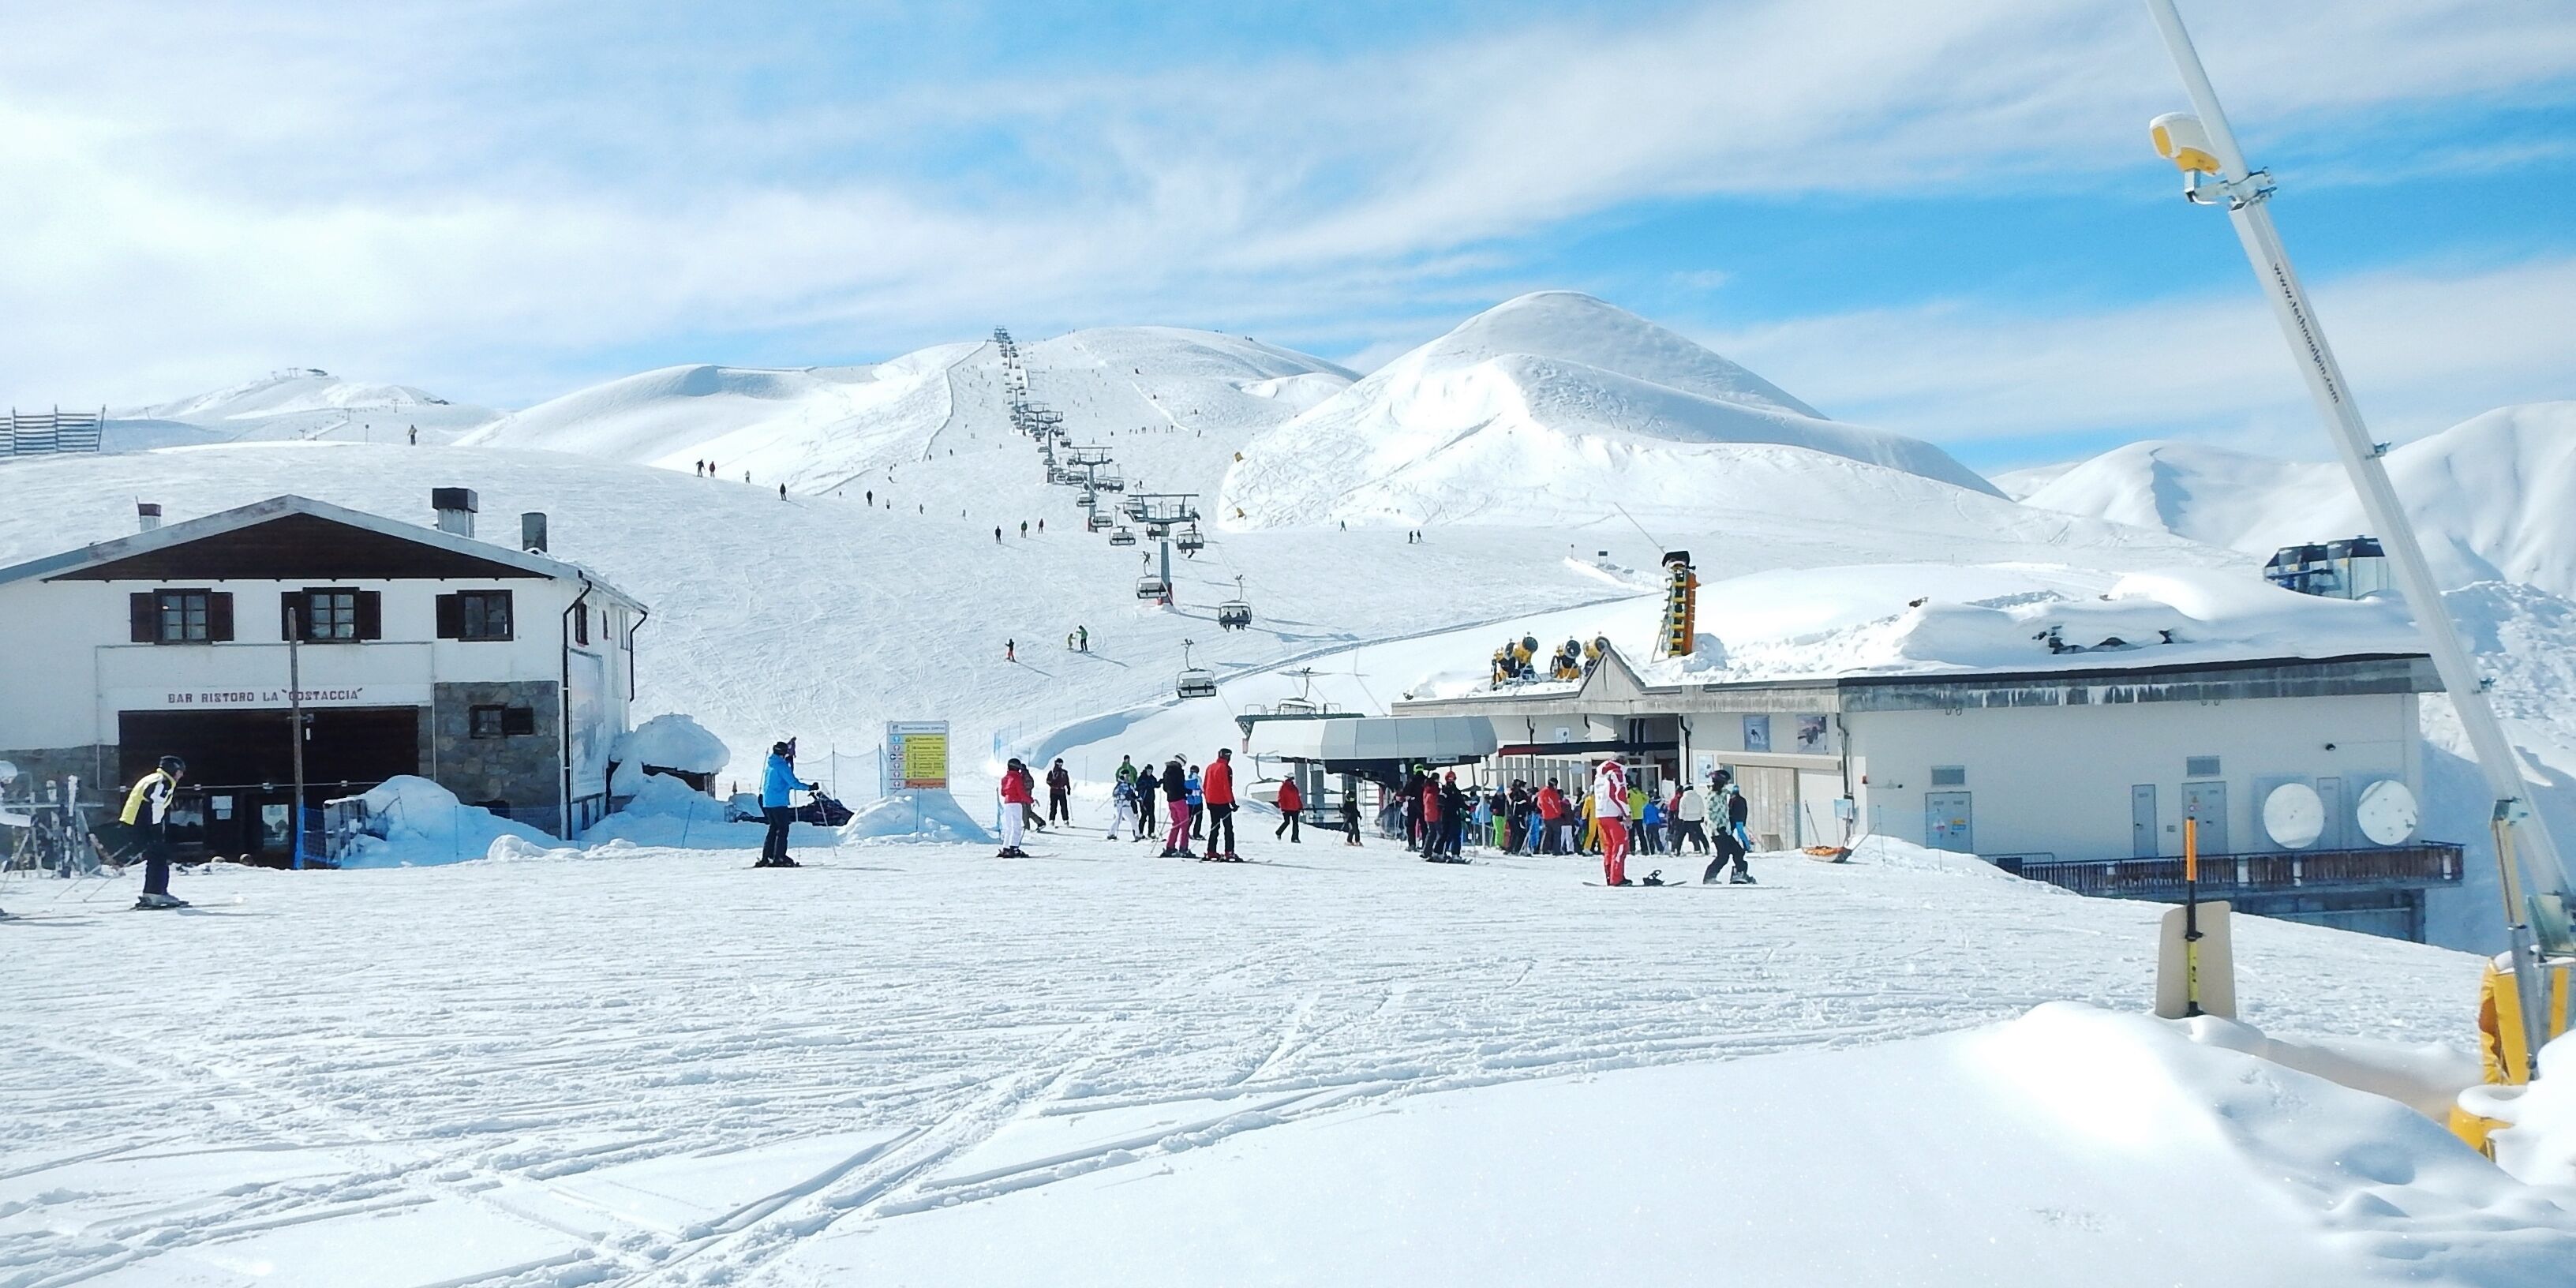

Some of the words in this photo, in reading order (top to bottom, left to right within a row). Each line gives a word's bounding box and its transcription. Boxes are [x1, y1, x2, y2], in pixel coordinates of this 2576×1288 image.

[2274, 263, 2339, 403] www.technoalpin.com
[168, 693, 193, 703] BAR
[201, 692, 254, 702] RISTORO
[263, 691, 279, 702] LA
